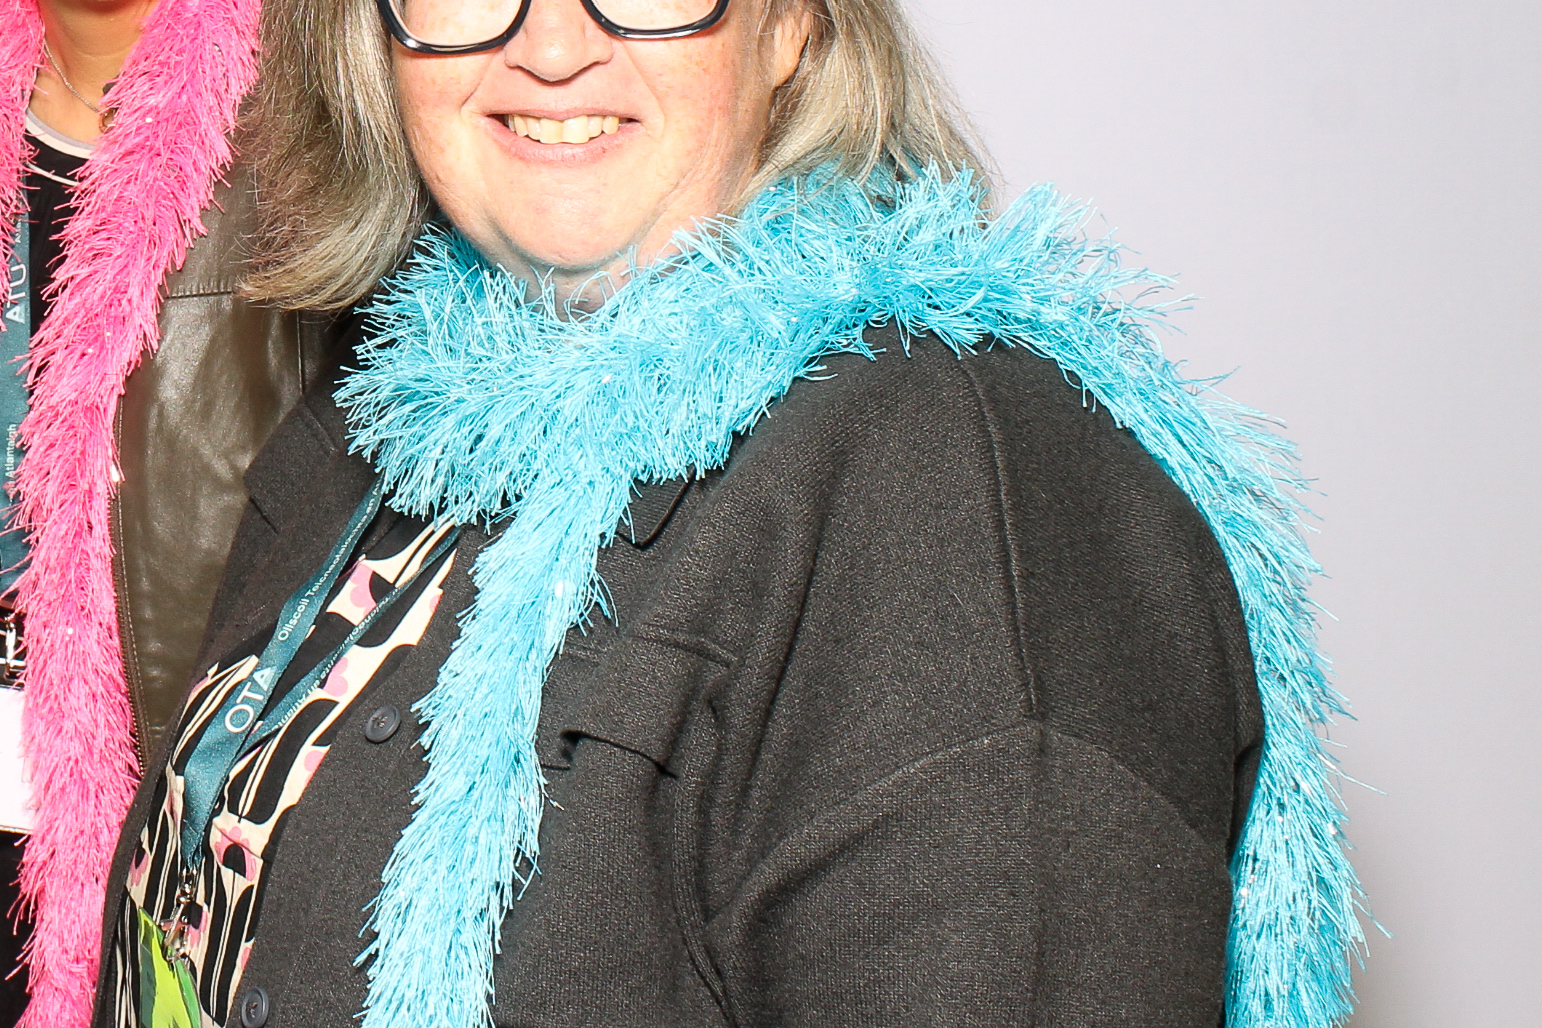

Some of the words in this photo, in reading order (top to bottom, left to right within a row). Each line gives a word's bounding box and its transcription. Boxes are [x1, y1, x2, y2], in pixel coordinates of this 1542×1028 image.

[5, 263, 28, 324] ATU
[277, 597, 310, 641] Ollscoil
[224, 666, 277, 733] OTA
